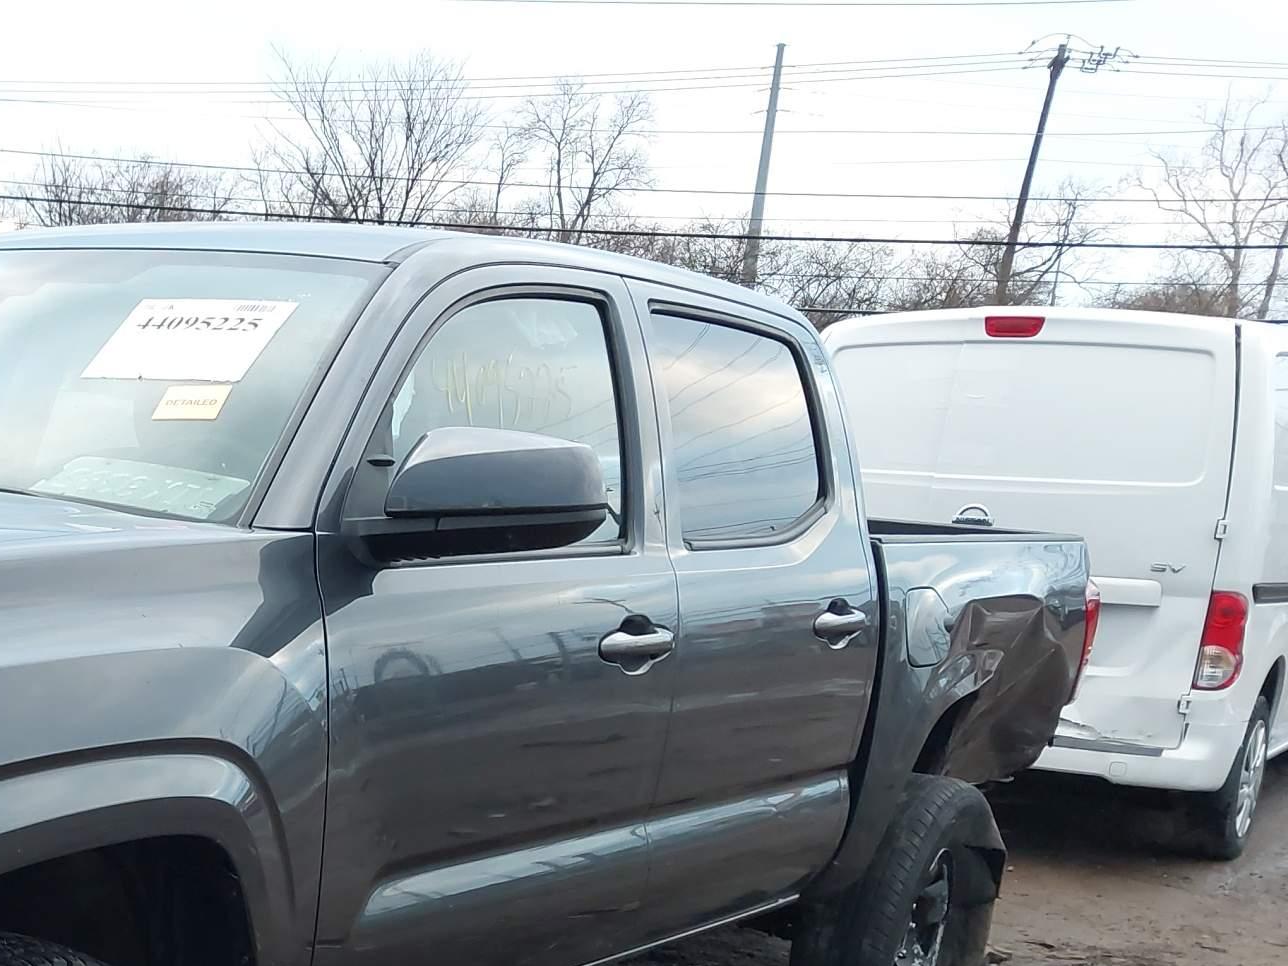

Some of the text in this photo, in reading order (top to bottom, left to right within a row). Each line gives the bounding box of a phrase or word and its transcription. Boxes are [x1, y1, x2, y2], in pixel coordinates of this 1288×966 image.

[136, 316, 263, 332] 44095225
[165, 398, 218, 407] DETAILED
[1150, 562, 1186, 574] SV
